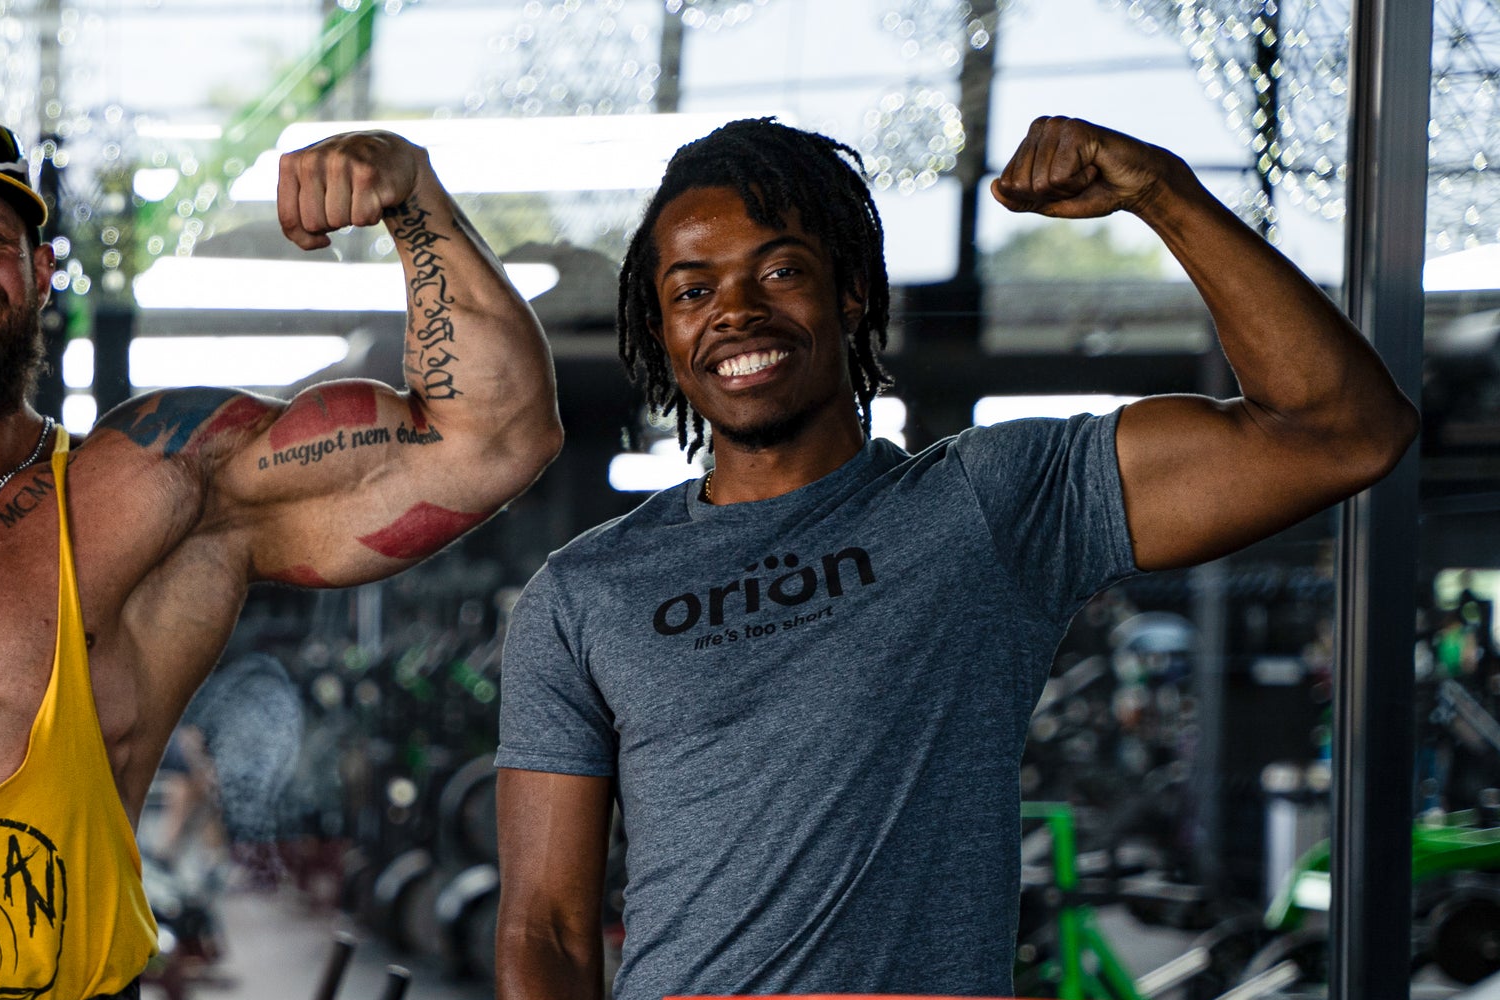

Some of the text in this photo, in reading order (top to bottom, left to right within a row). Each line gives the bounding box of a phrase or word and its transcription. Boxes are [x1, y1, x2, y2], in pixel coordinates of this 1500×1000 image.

[257, 456, 269, 470] a
[273, 430, 347, 466] nagyot
[351, 426, 391, 448] nem
[693, 605, 833, 651] life's too short
